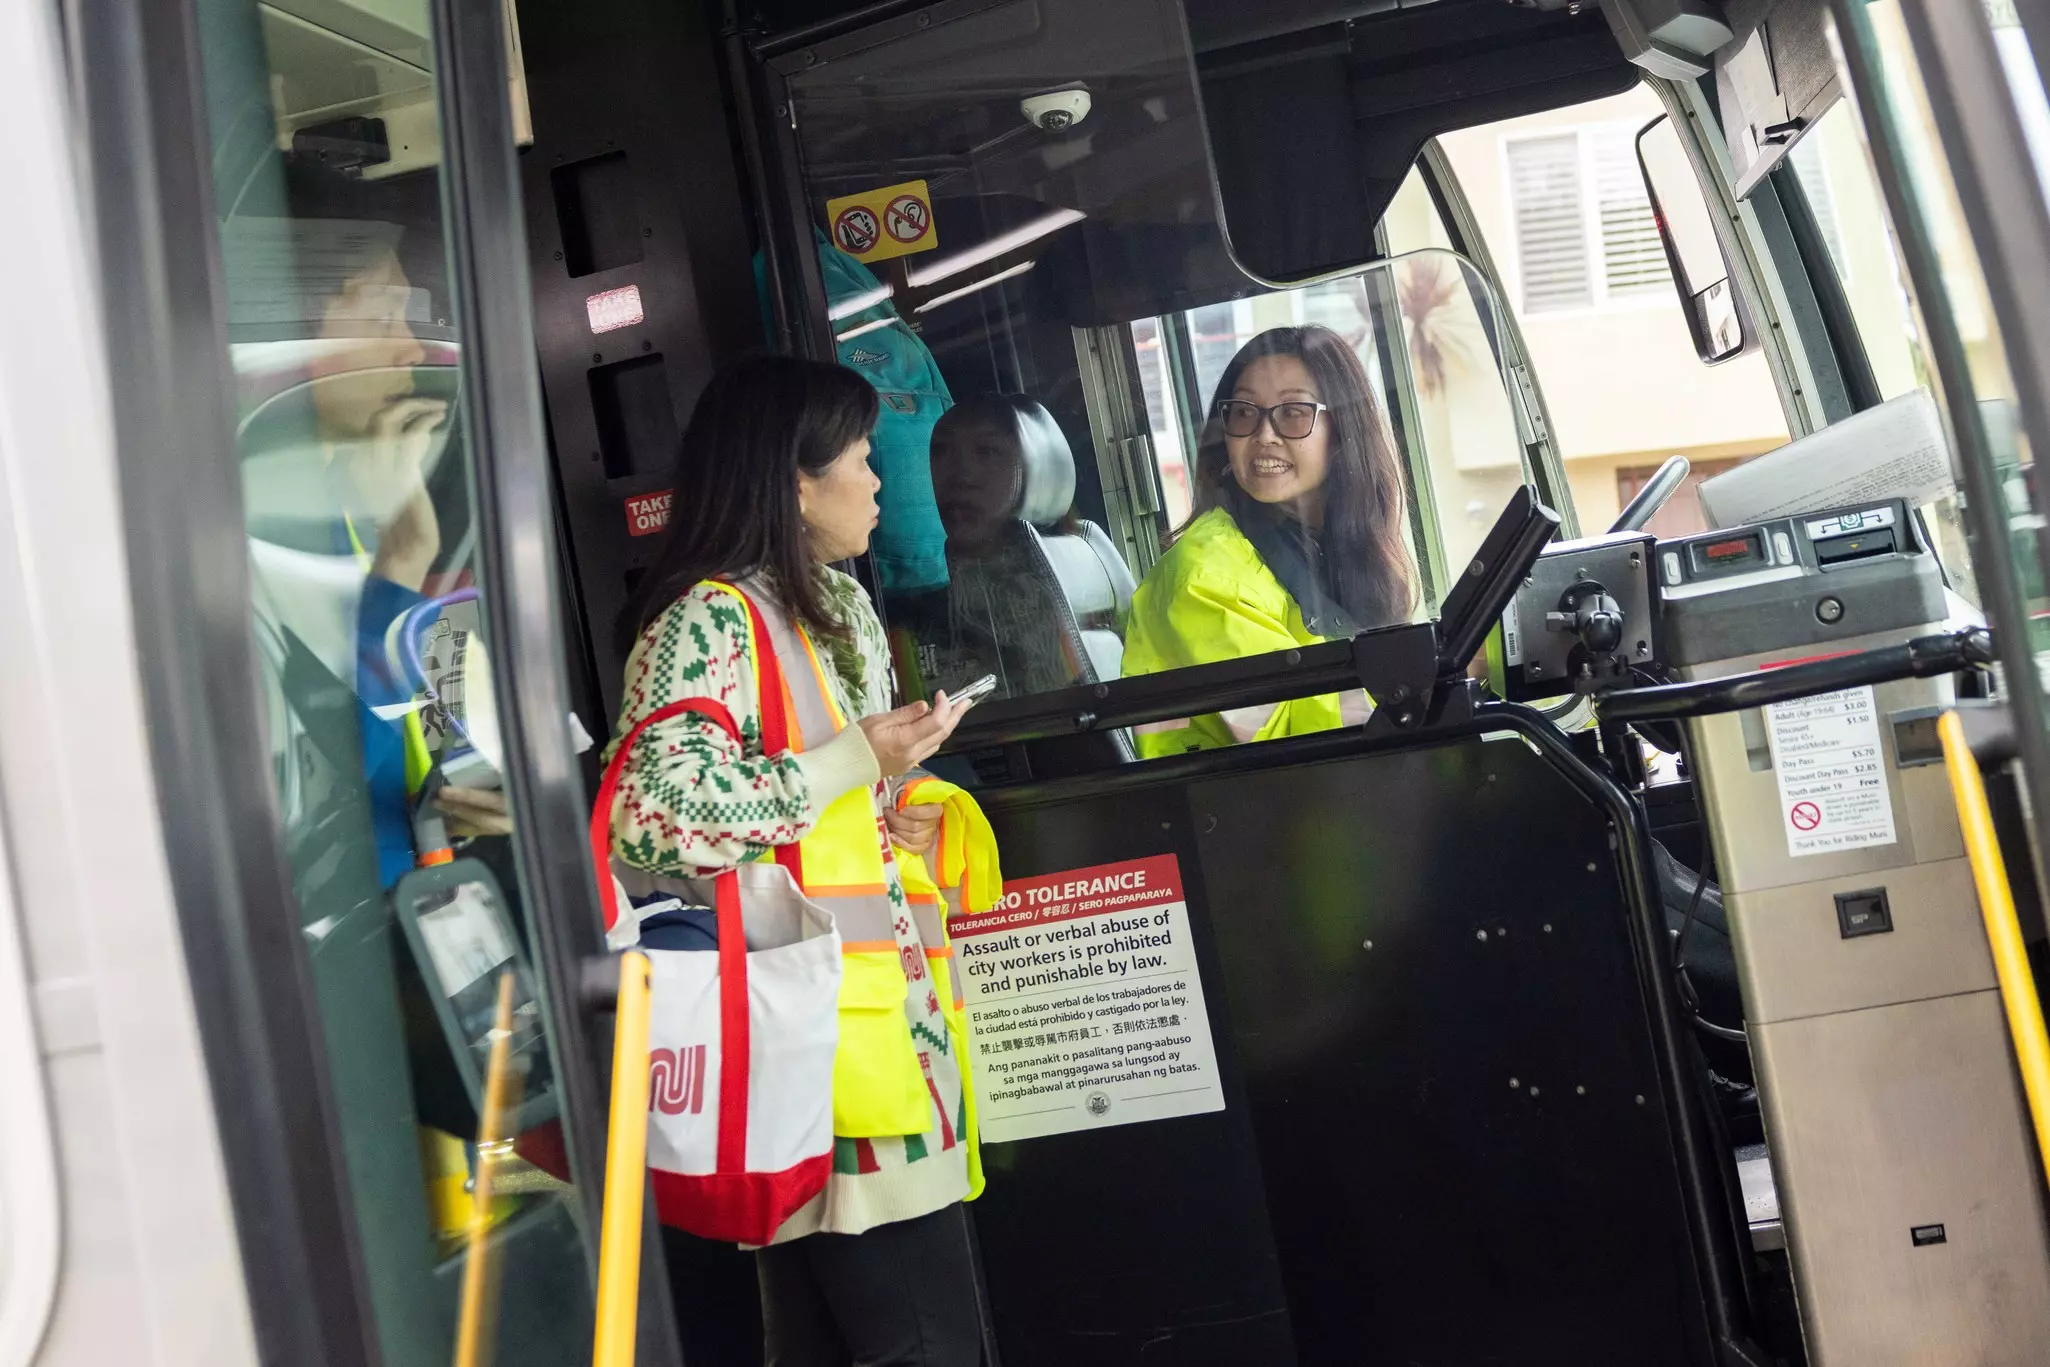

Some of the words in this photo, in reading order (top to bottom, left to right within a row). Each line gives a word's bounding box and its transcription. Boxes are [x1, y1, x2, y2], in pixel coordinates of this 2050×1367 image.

[628, 494, 673, 516] TAKE
[636, 510, 672, 530] ONE
[1775, 712, 1795, 720] Adult
[1844, 701, 1867, 710] $3.00
[1842, 689, 1864, 699] given
[1847, 715, 1869, 724] $1.50
[1782, 760, 1796, 768] Day
[1798, 757, 1814, 765] Pass
[1852, 748, 1875, 757] $5.70
[1818, 770, 1831, 778] Day
[1833, 767, 1848, 775] Pass
[1855, 763, 1877, 772] $2.85
[1787, 788, 1808, 796] Youth
[1809, 784, 1831, 793] under
[1860, 777, 1879, 786] Free
[1025, 869, 1146, 906] TOLERANCE
[950, 915, 1007, 932] TOLERANCIA
[1007, 910, 1033, 923] CERO
[1033, 908, 1040, 921] /
[1070, 902, 1077, 914] /
[1078, 898, 1104, 911] SERO
[1103, 887, 1173, 907] PAGPAPARAYA
[962, 934, 1021, 958] Assault
[1024, 934, 1041, 947] or
[1044, 920, 1096, 944] verbal
[1100, 916, 1149, 935] abuse
[1153, 908, 1170, 926] of
[967, 960, 996, 977] city
[999, 950, 1066, 971] workers
[1068, 944, 1083, 960] is
[1085, 928, 1172, 961] prohibited
[980, 974, 1011, 994] and
[1014, 961, 1104, 992] punishable
[1106, 958, 1128, 976] by
[1131, 954, 1167, 970] law.
[972, 1011, 982, 1022] El
[982, 1008, 1011, 1021] asalto
[1012, 1007, 1020, 1016] o
[1020, 1002, 1050, 1015] abuso
[1050, 995, 1081, 1010] verbal
[1081, 994, 1095, 1005] de
[1095, 992, 1111, 1003] los
[1110, 983, 1172, 1000] trabajadores
[1172, 980, 1186, 991] de
[974, 1026, 984, 1036] la
[984, 1020, 1017, 1034] ciudad
[1017, 1016, 1038, 1029] está
[1039, 1009, 1086, 1028] prohibido
[1086, 1010, 1094, 1021] y
[1094, 1001, 1141, 1017] castigado
[1142, 1000, 1160, 1012] por
[1160, 996, 1170, 1007] la
[1170, 995, 1189, 1007] ley.
[987, 1062, 1009, 1073] Ang
[1010, 1052, 1061, 1072] pananakit
[1062, 1053, 1070, 1062] o
[1071, 1045, 1124, 1063] pasalitang
[1125, 1035, 1192, 1054] pang-aabuso
[1002, 1076, 1015, 1085] sa
[1016, 1072, 1039, 1084] mga
[1040, 1061, 1110, 1079] manggagawa
[1111, 1059, 1124, 1069] sa
[1124, 1050, 1166, 1067] lungsod
[1168, 1051, 1180, 1062] ay
[988, 1080, 1064, 1103] ipinagbabawal
[1065, 1079, 1076, 1090] at
[1077, 1069, 1152, 1090] pinarurusahan
[1152, 1067, 1167, 1078] ng
[1168, 1063, 1201, 1074] batas.
